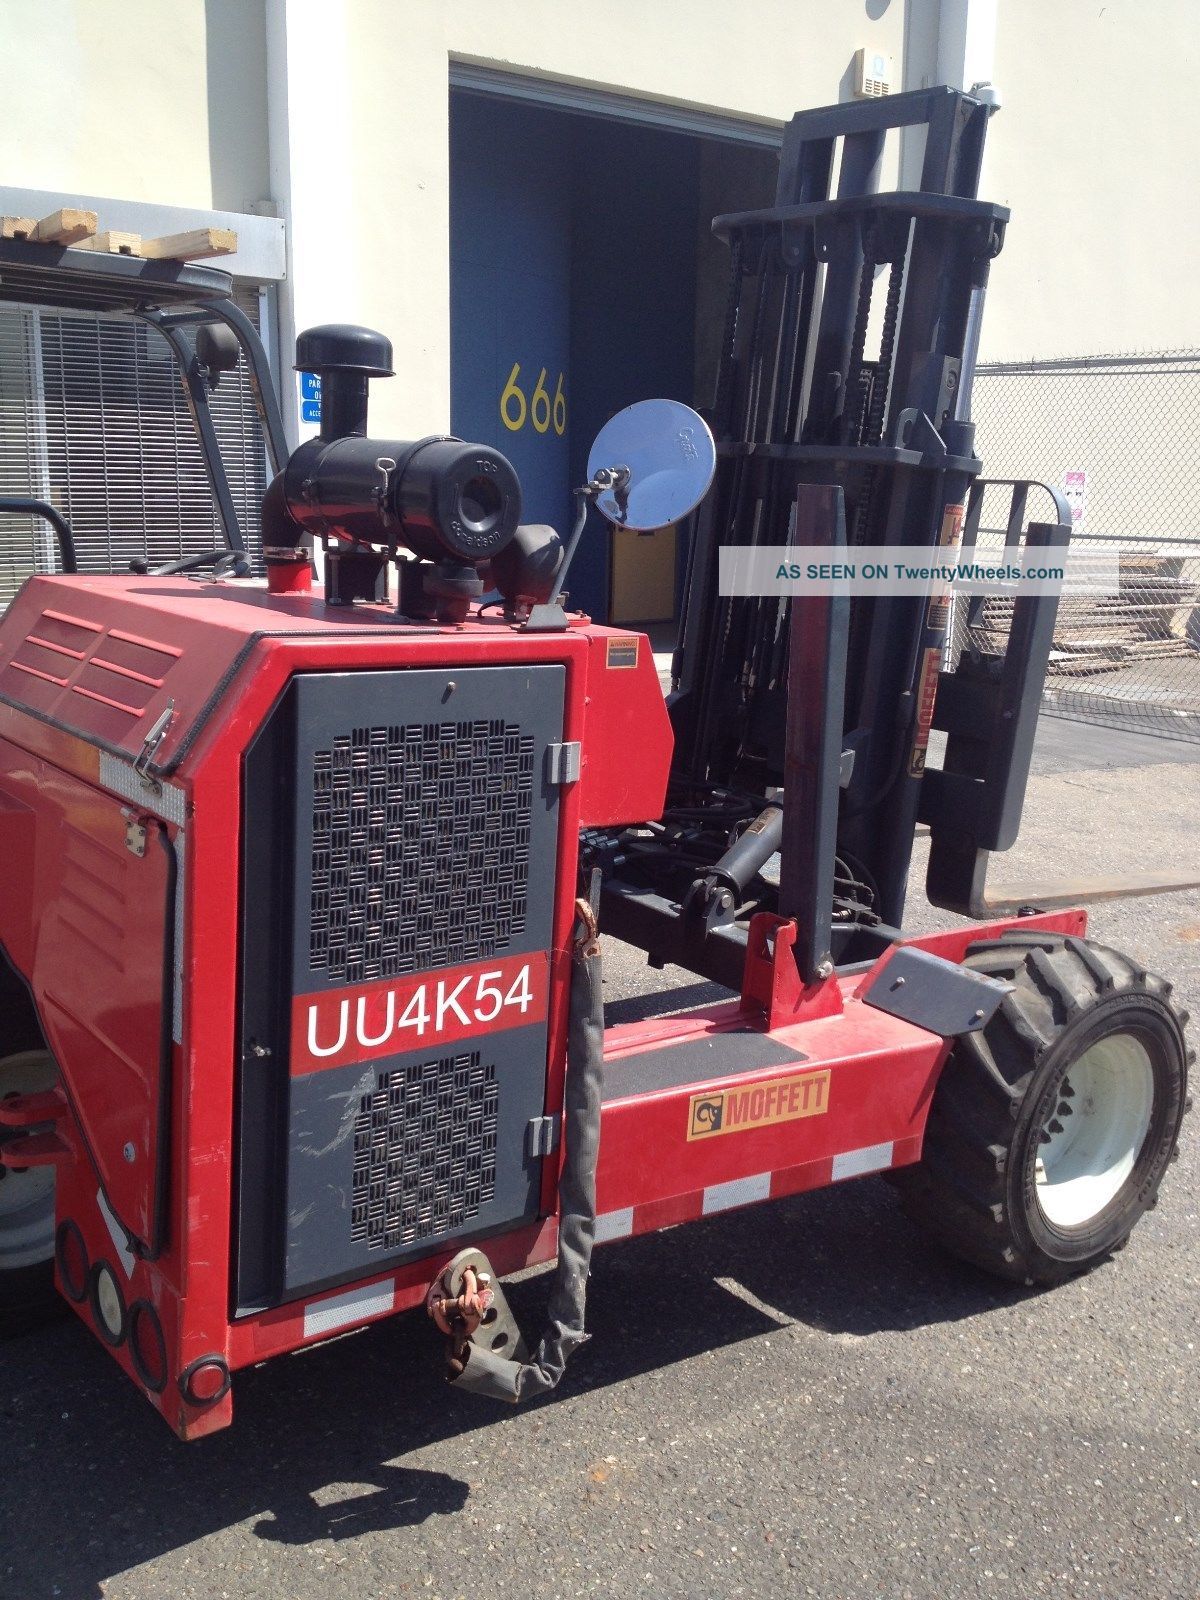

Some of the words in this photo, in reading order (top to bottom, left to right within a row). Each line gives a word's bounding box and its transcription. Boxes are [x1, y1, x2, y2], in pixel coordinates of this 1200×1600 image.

[501, 362, 566, 435] 666
[916, 650, 941, 745] MOFFETT
[307, 964, 533, 1057] UU4K54
[725, 1077, 827, 1126] MOFFETT
